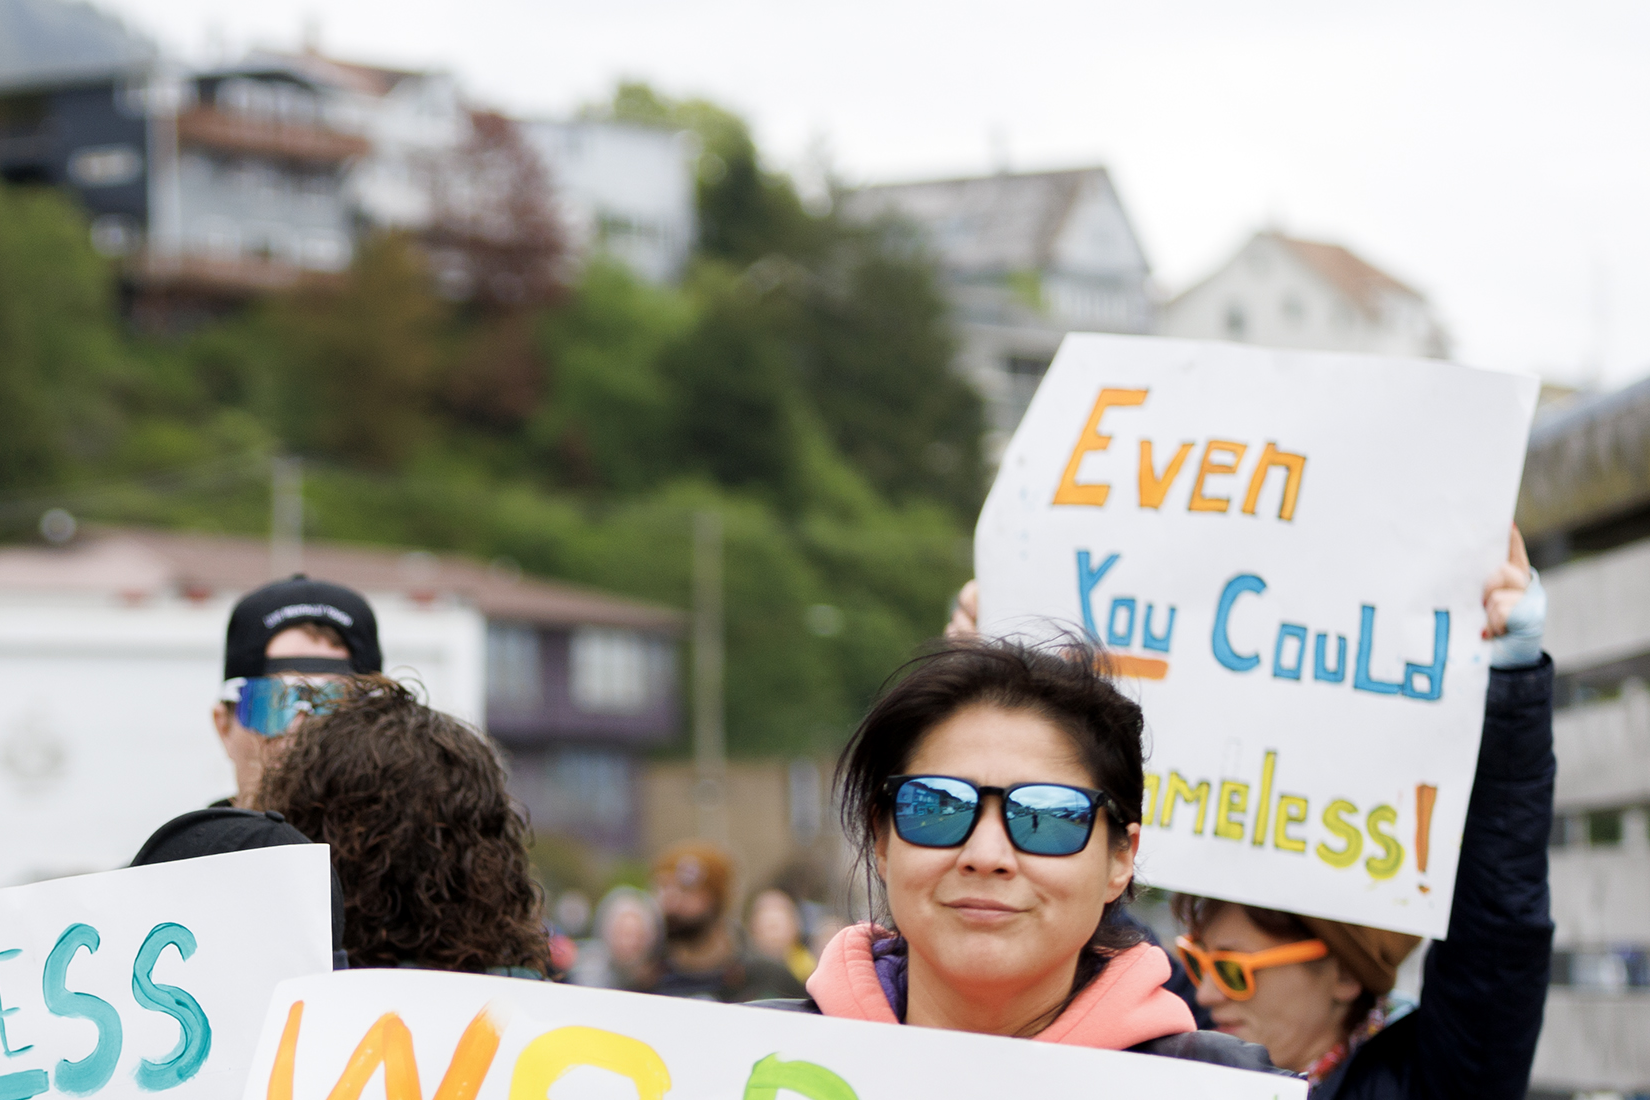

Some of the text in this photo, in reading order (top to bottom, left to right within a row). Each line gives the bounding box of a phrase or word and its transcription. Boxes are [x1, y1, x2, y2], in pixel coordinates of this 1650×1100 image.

[1052, 387, 1307, 522] Even
[1077, 549, 1177, 653] You
[1143, 750, 1438, 894] meless!
